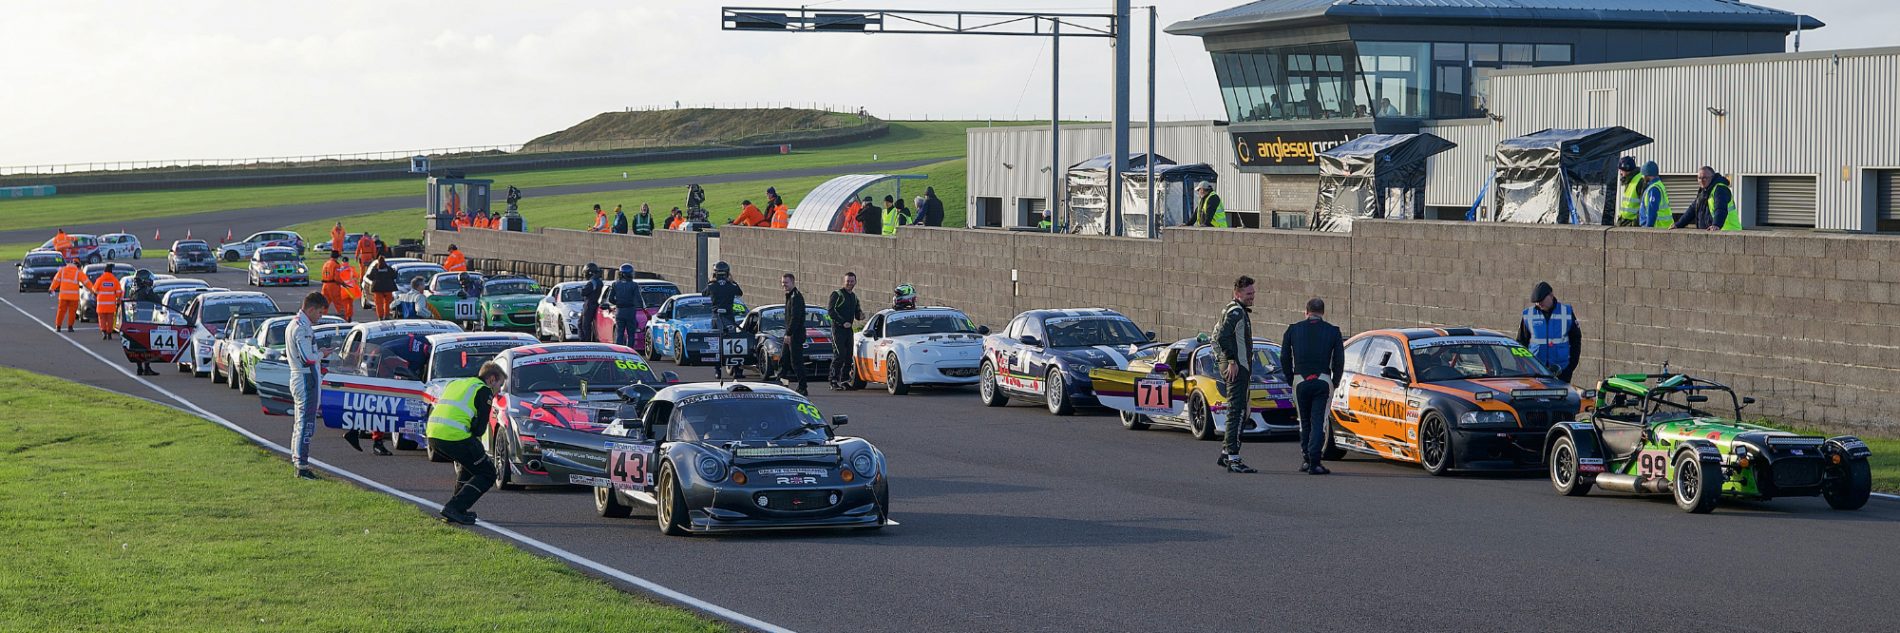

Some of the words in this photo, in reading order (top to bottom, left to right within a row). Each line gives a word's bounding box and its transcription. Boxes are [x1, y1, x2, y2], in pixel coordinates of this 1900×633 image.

[457, 303, 473, 315] 101
[154, 334, 175, 348] 44
[726, 339, 744, 355] 16
[614, 359, 649, 372] 666
[725, 357, 745, 366] LSR
[1141, 384, 1165, 405] 71
[343, 392, 402, 414] LUCKY
[797, 403, 821, 419] 43
[342, 411, 399, 432] SAINT
[613, 452, 645, 484] 43
[1641, 453, 1667, 477] 99
